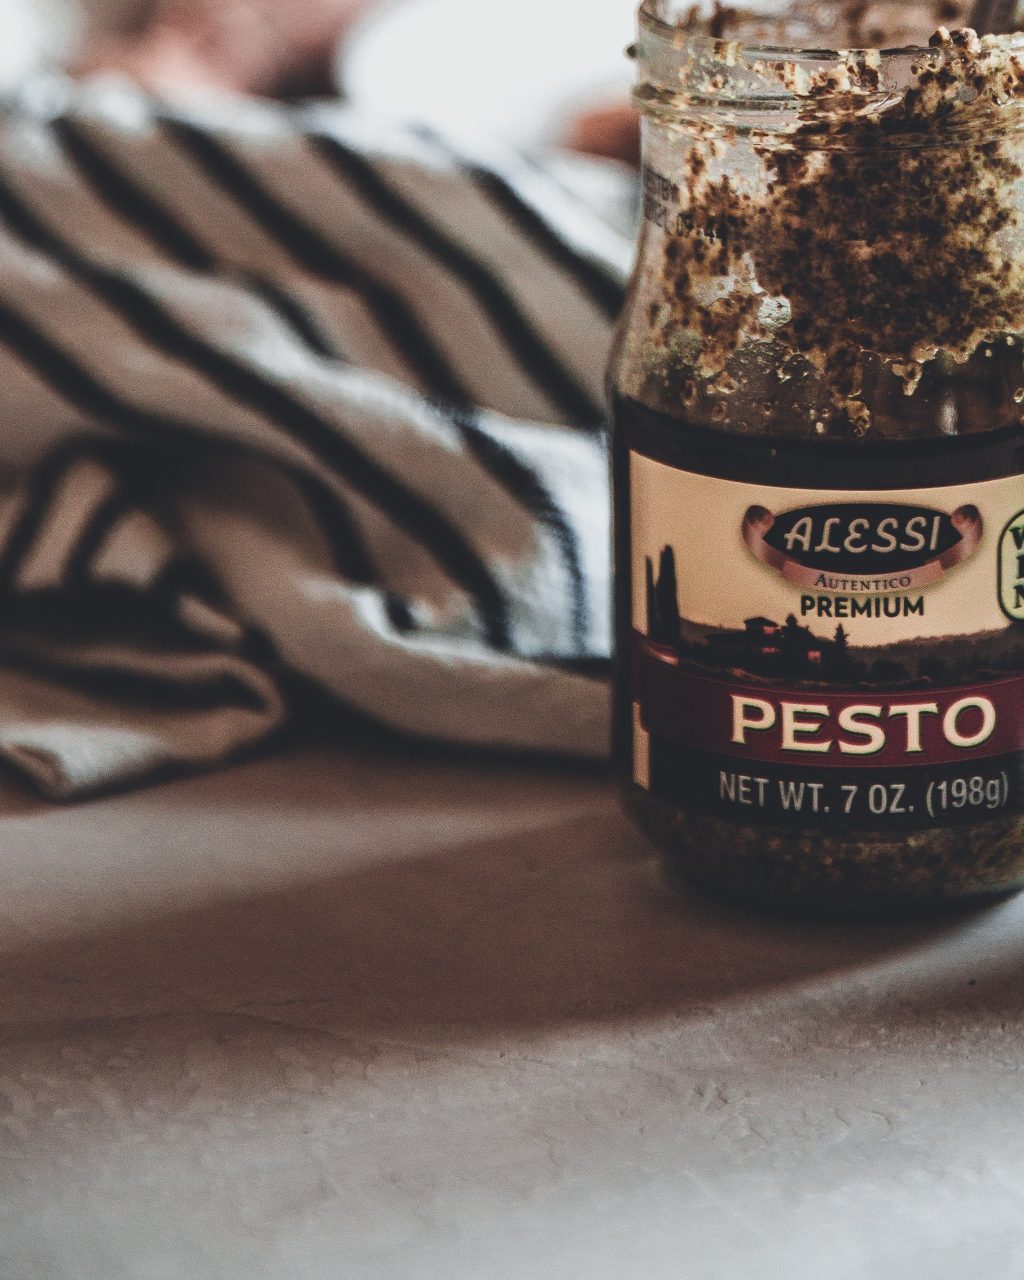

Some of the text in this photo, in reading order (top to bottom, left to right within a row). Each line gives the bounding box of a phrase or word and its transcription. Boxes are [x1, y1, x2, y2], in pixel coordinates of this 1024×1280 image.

[784, 516, 941, 554] ALESSI
[814, 573, 912, 592] AUTENTICO
[800, 594, 925, 619] PREMIUM
[730, 694, 997, 755] PESTO
[719, 771, 1009, 818] NET WT. 7 OZ. (198g)
